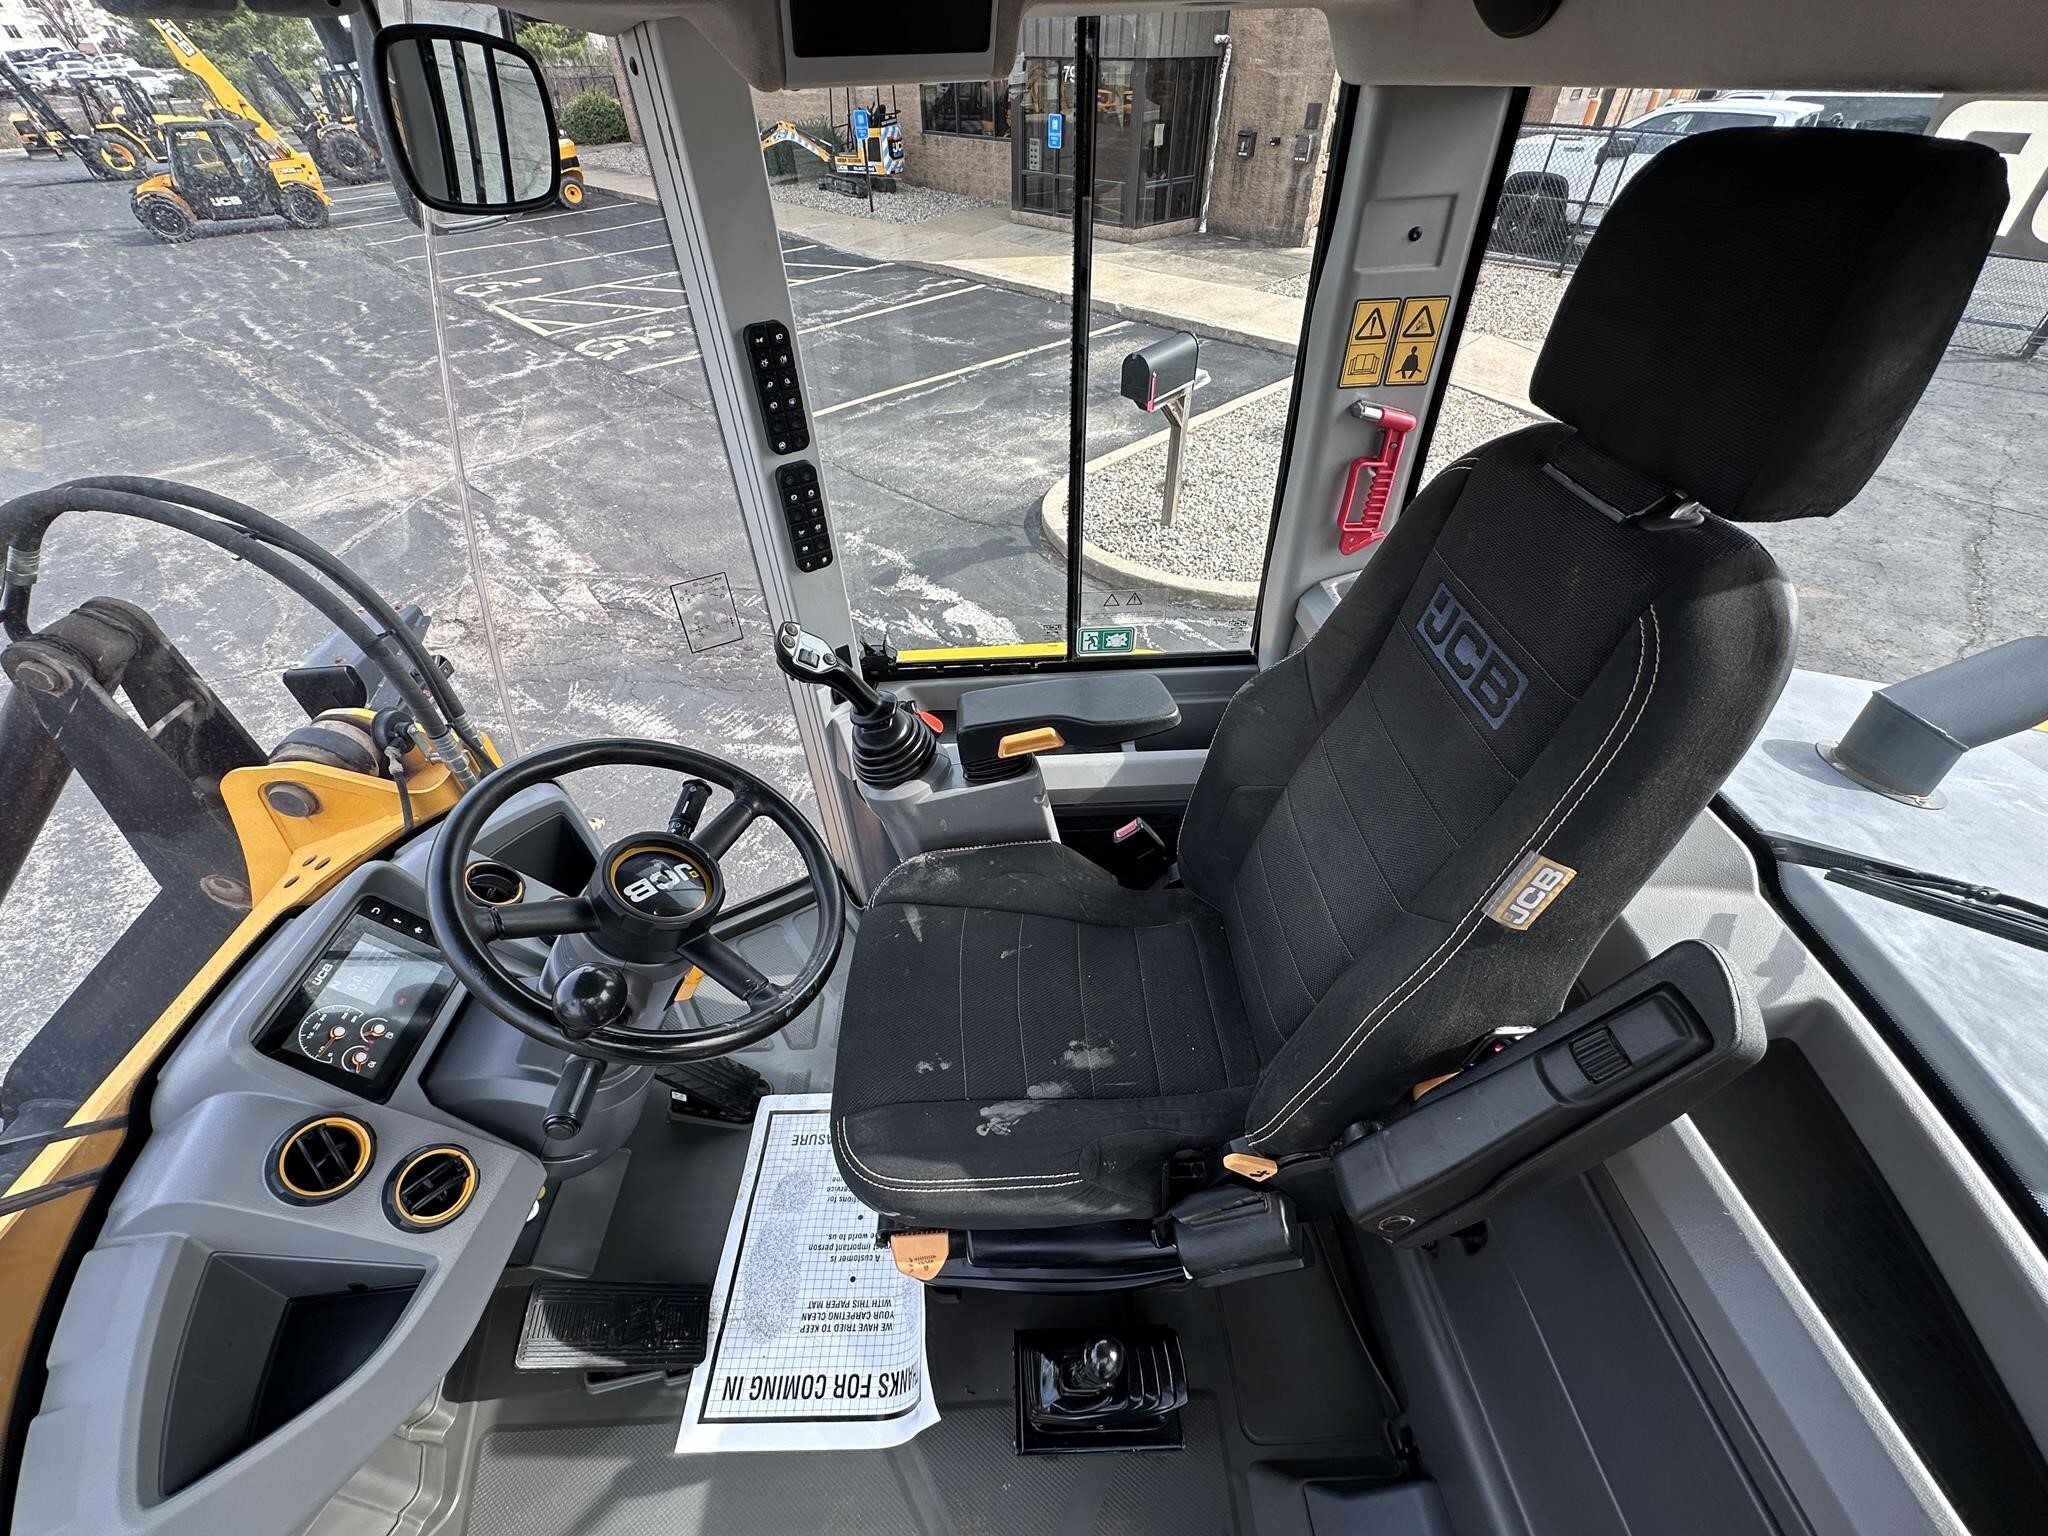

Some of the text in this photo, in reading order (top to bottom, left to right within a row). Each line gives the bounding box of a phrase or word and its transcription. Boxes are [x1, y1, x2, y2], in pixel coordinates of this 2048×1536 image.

[154, 19, 197, 57] JCB
[892, 141, 903, 153] JC
[210, 196, 242, 206] JCB
[1420, 584, 1523, 722] JCB
[623, 863, 698, 903] JCB
[1502, 867, 1564, 925] JCB
[312, 963, 333, 986] JCB
[791, 1134, 831, 1146] ASURE
[827, 1195, 859, 1204] tions for
[839, 1232, 846, 1240] to
[848, 1232, 868, 1240] world
[808, 1243, 834, 1251] person
[835, 1242, 871, 1251] important
[830, 1254, 881, 1263] A customer is
[807, 1299, 892, 1309] WITH THIS PAPER MAT
[801, 1311, 894, 1321] YOUR CARPETING CLEAN
[800, 1322, 893, 1333] WE HAVE TRIED TO KEEP
[722, 1376, 744, 1400] IN
[750, 1374, 827, 1400] COMING
[833, 1373, 872, 1399] FOR
